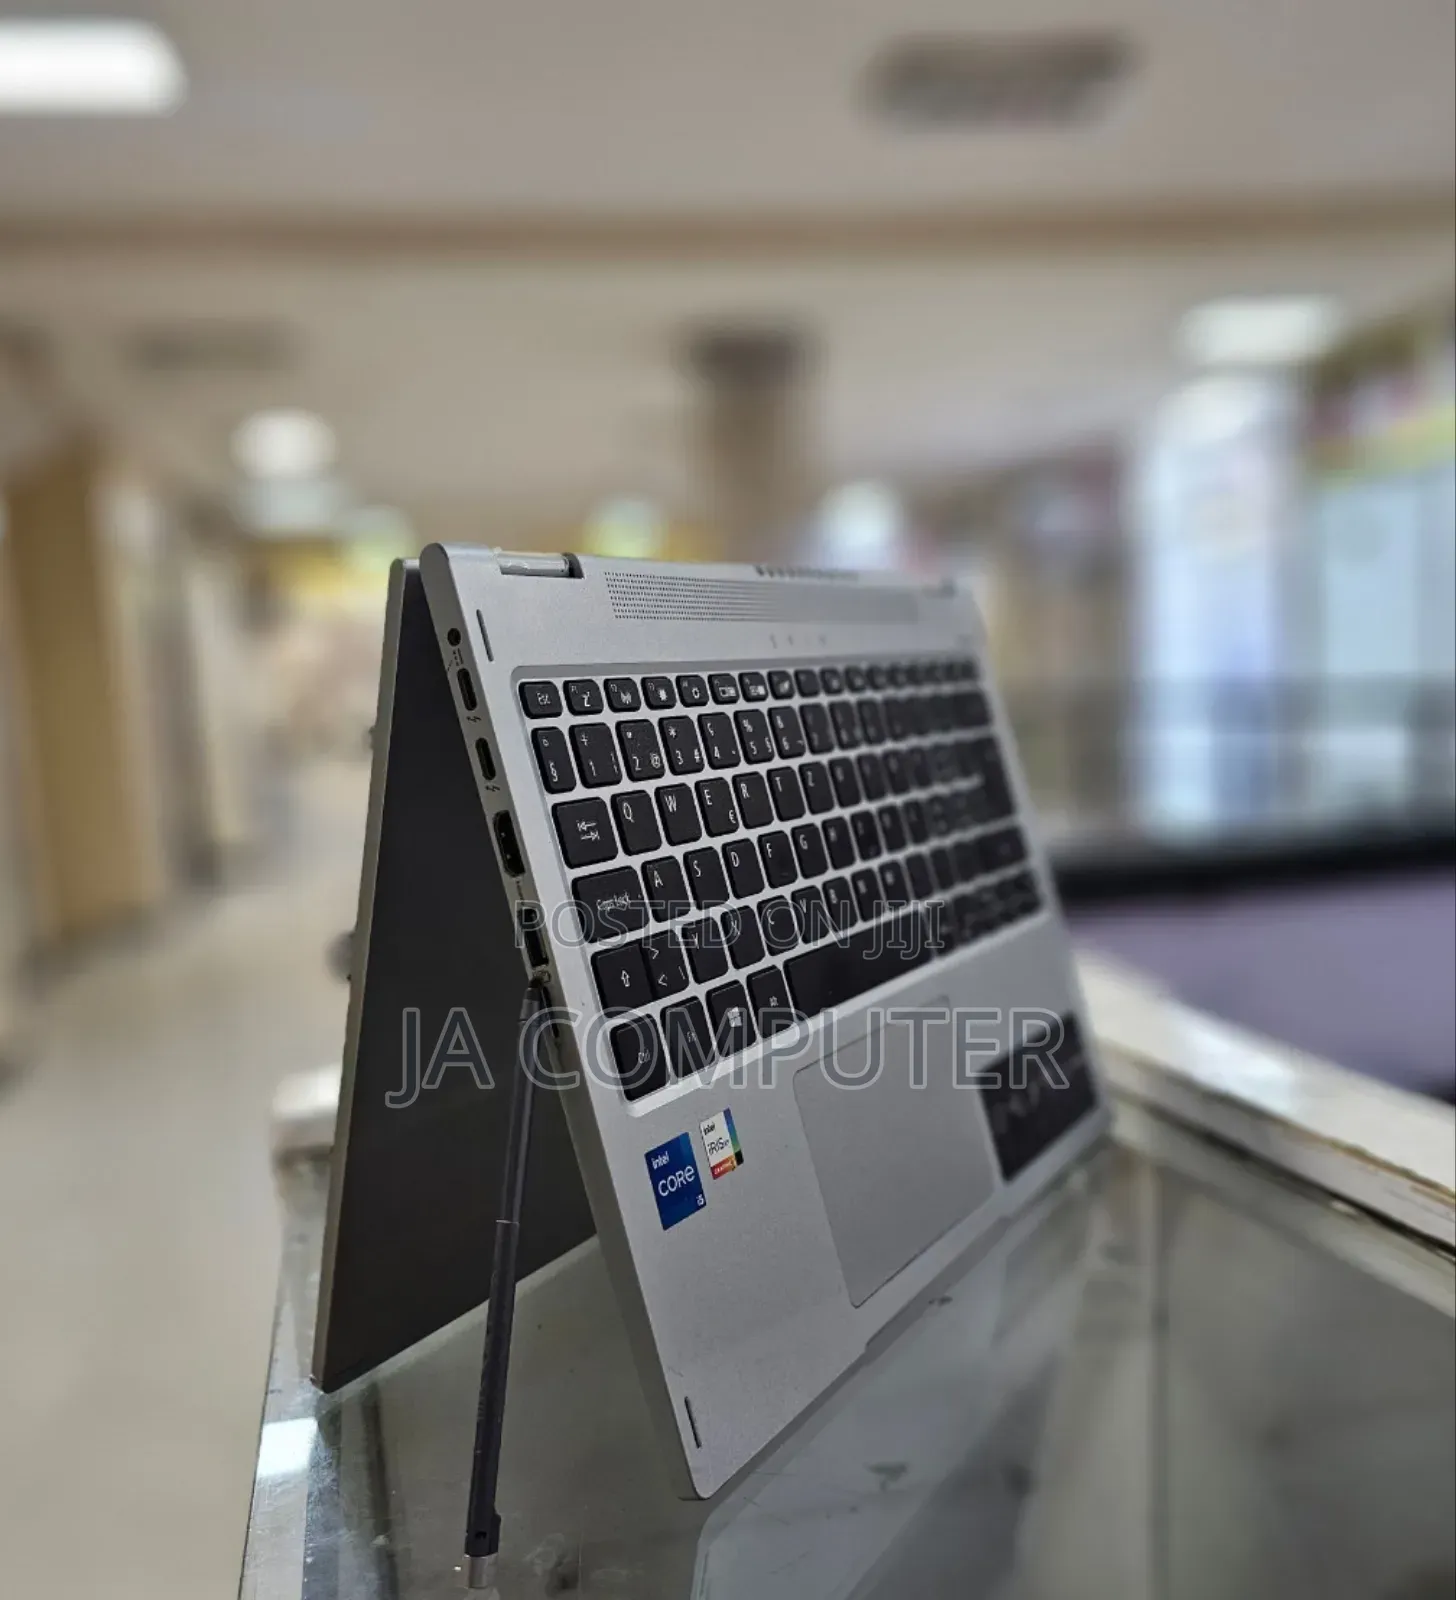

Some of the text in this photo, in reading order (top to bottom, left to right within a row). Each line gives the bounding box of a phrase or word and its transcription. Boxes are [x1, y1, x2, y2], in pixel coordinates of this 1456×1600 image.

[714, 745, 721, 759] 4
[750, 741, 758, 755] 5
[632, 755, 642, 771] 2
[676, 749, 684, 765] 3
[740, 783, 750, 799] R
[775, 776, 783, 792] T
[665, 794, 677, 813] W
[704, 789, 713, 805] E
[623, 803, 635, 822] Q
[800, 834, 809, 850] G
[766, 843, 773, 859] F
[731, 851, 740, 868] D
[692, 860, 702, 878] S
[653, 870, 664, 888] A
[651, 1151, 670, 1170] intel
